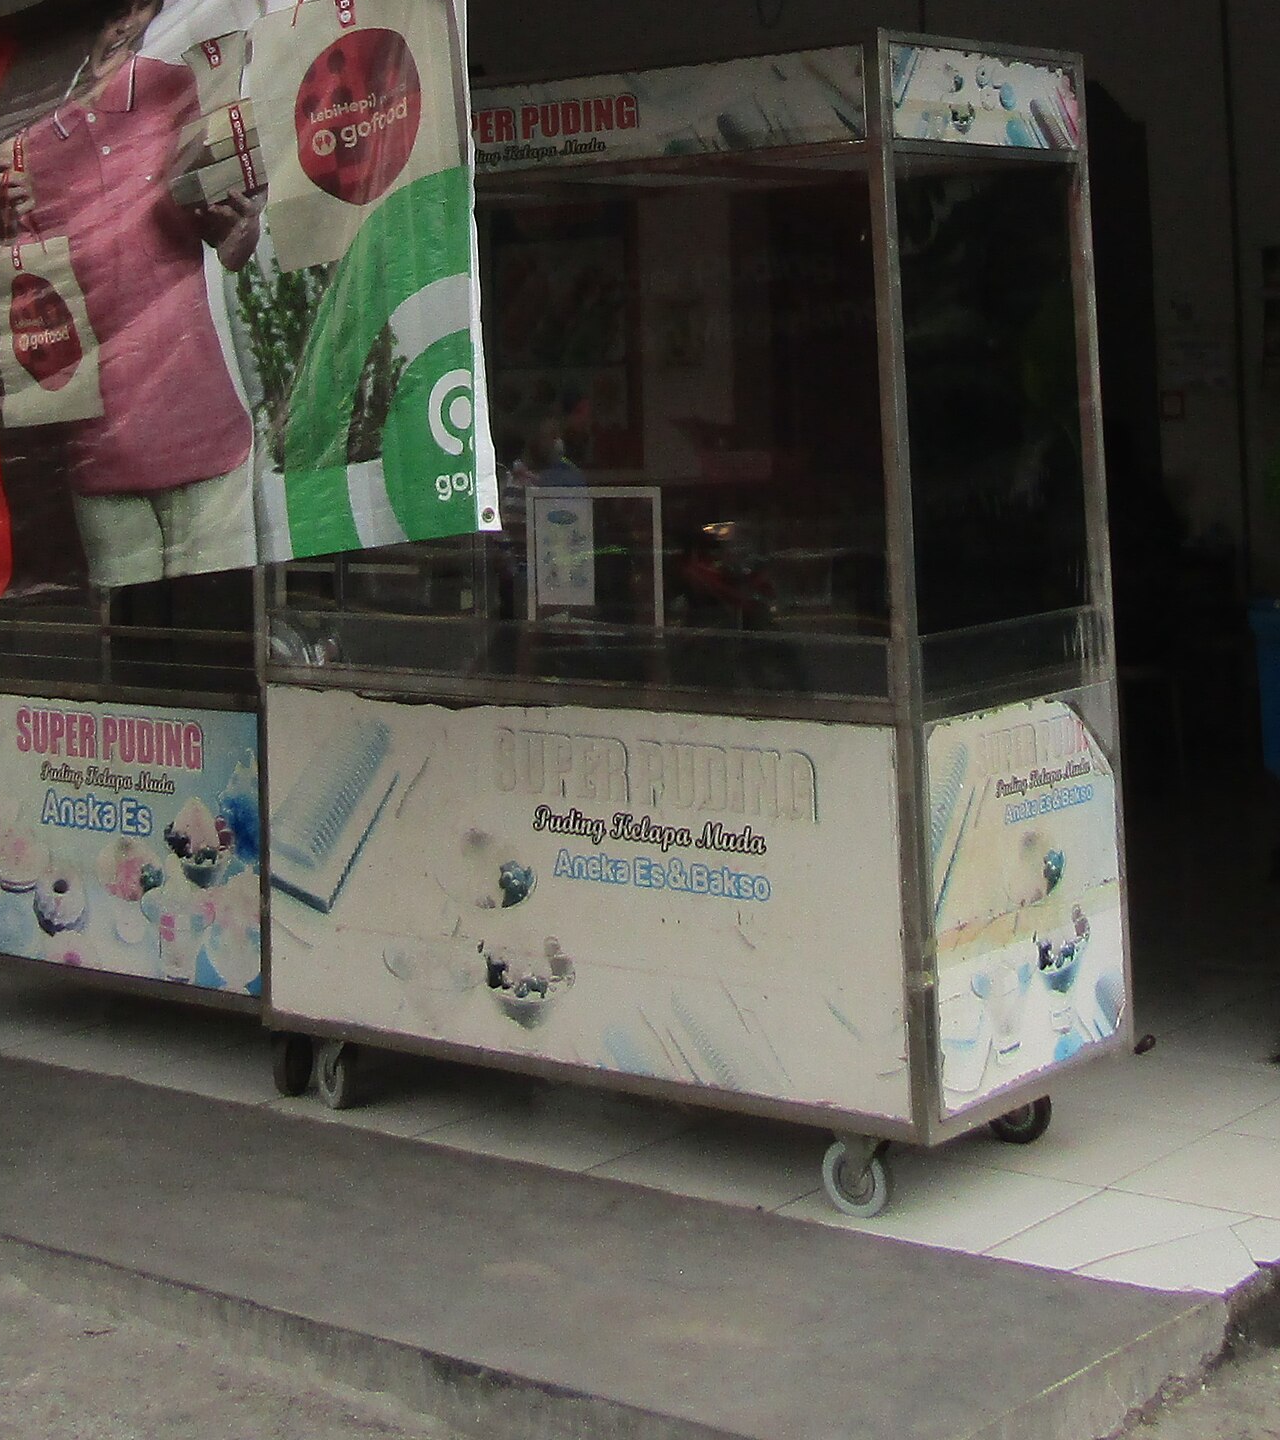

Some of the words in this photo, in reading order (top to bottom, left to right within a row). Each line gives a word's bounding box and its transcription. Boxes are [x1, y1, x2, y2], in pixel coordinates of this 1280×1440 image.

[340, 96, 408, 149] gofood
[520, 91, 640, 141] PUDING
[503, 143, 558, 166] Kelapa
[558, 137, 608, 157] Muda
[15, 706, 97, 760] SUPER
[101, 714, 205, 772] PUDING
[40, 761, 84, 789] Puding
[84, 765, 134, 794] Kelapa
[134, 770, 176, 795] Muda
[995, 775, 1029, 799] Puding
[1029, 767, 1063, 790] Kelapa
[1062, 757, 1092, 779] Muda
[41, 788, 119, 832] Aneka
[120, 796, 153, 837] Es
[1004, 799, 1038, 825] Aneka
[1061, 783, 1095, 808] Bakso
[532, 804, 608, 845] Puding
[609, 812, 692, 853] Kelapa
[695, 821, 768, 856] Muda
[553, 848, 631, 885] Aneka
[632, 856, 666, 889] Es
[689, 862, 773, 903] Bakso
